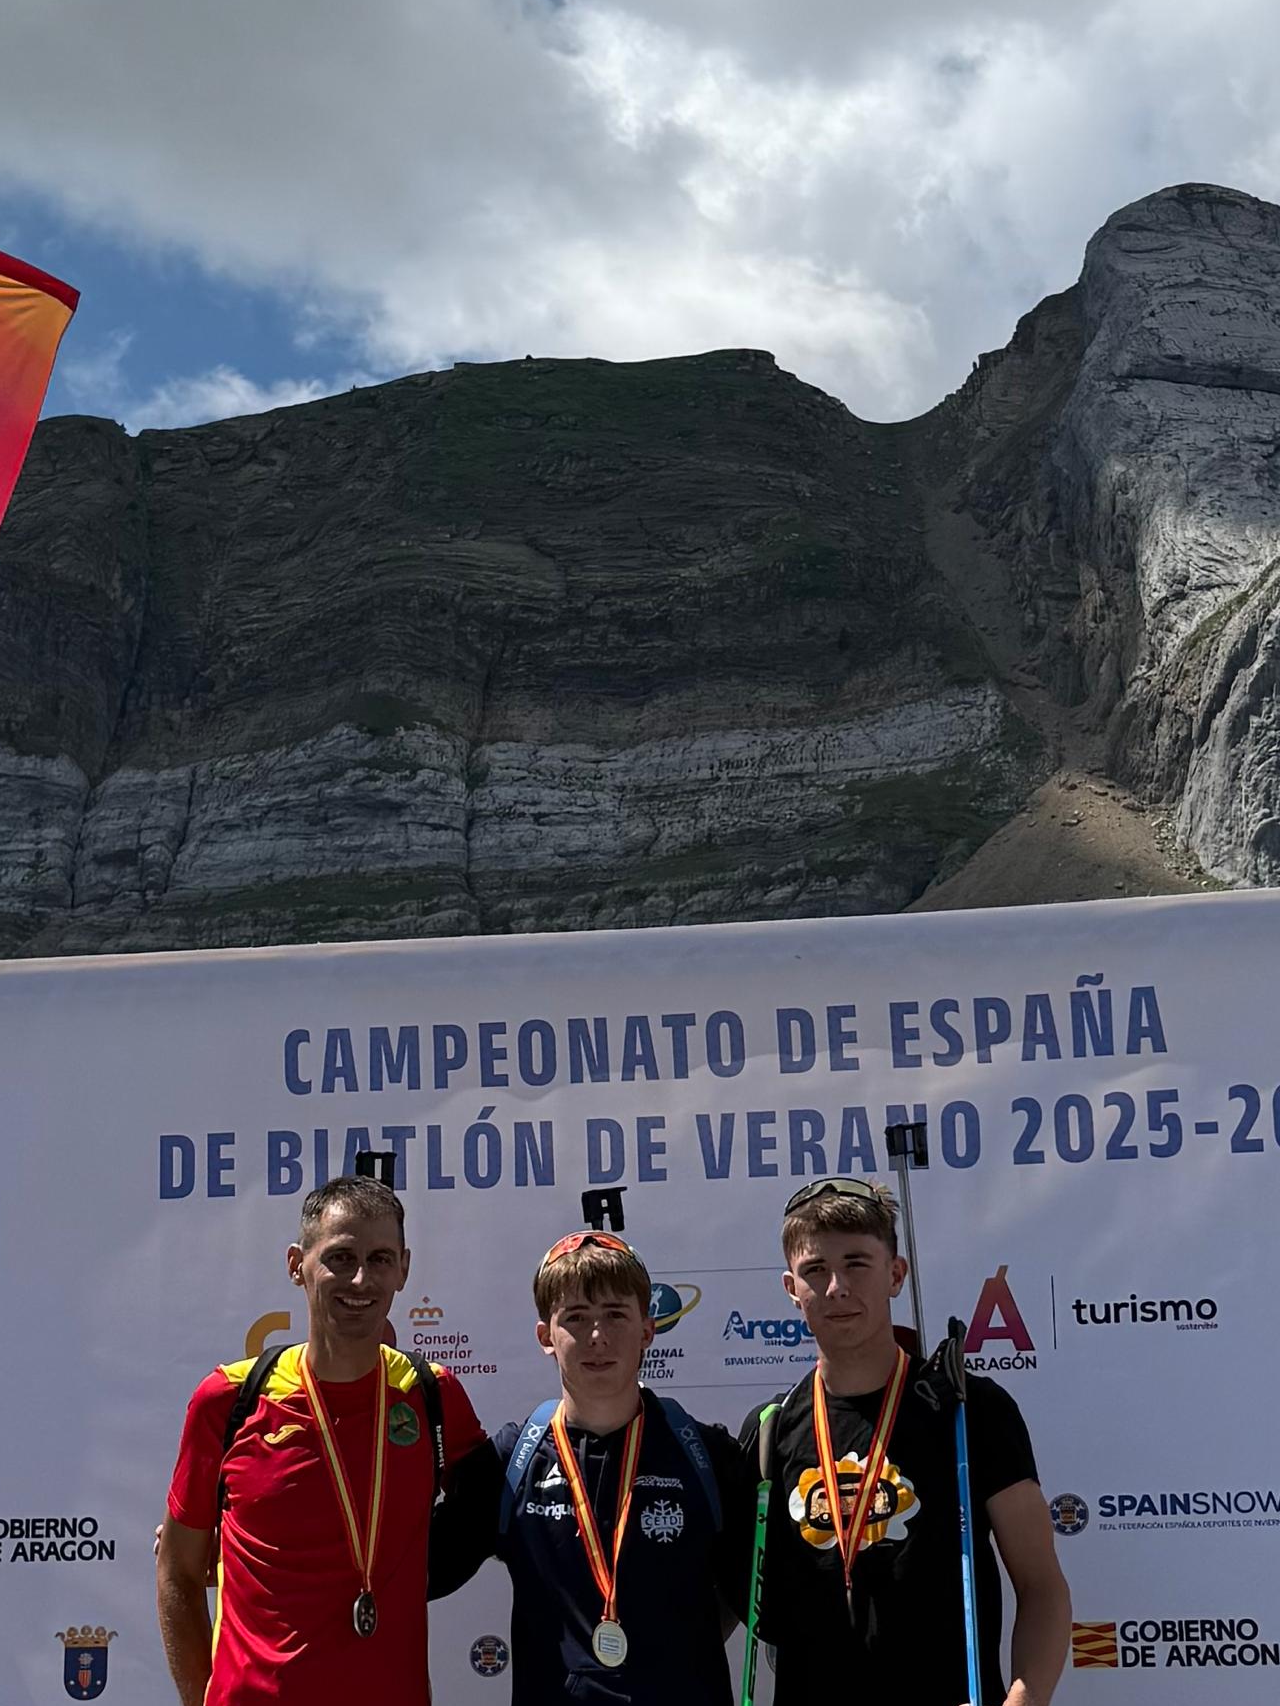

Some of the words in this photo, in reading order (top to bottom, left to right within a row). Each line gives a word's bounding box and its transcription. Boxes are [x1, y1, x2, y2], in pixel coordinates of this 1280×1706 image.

[283, 1010, 746, 1097] CAMPEONATO
[777, 1003, 860, 1076] DE
[890, 972, 1169, 1070] ESPAÑA
[159, 1131, 236, 1200] DE
[267, 1105, 557, 1197] BIATLÓN
[586, 1115, 668, 1187] DE
[696, 1099, 982, 1181] VERANO
[1072, 1293, 1218, 1325] turismo
[413, 1331, 469, 1350] Consejo
[964, 1352, 1038, 1371] ARAGÓN
[10, 1540, 115, 1563] ARAGON
[1120, 1618, 1259, 1643] GOBIERNO
[1121, 1645, 1156, 1667] DE
[1165, 1643, 1280, 1667] ARAGON
